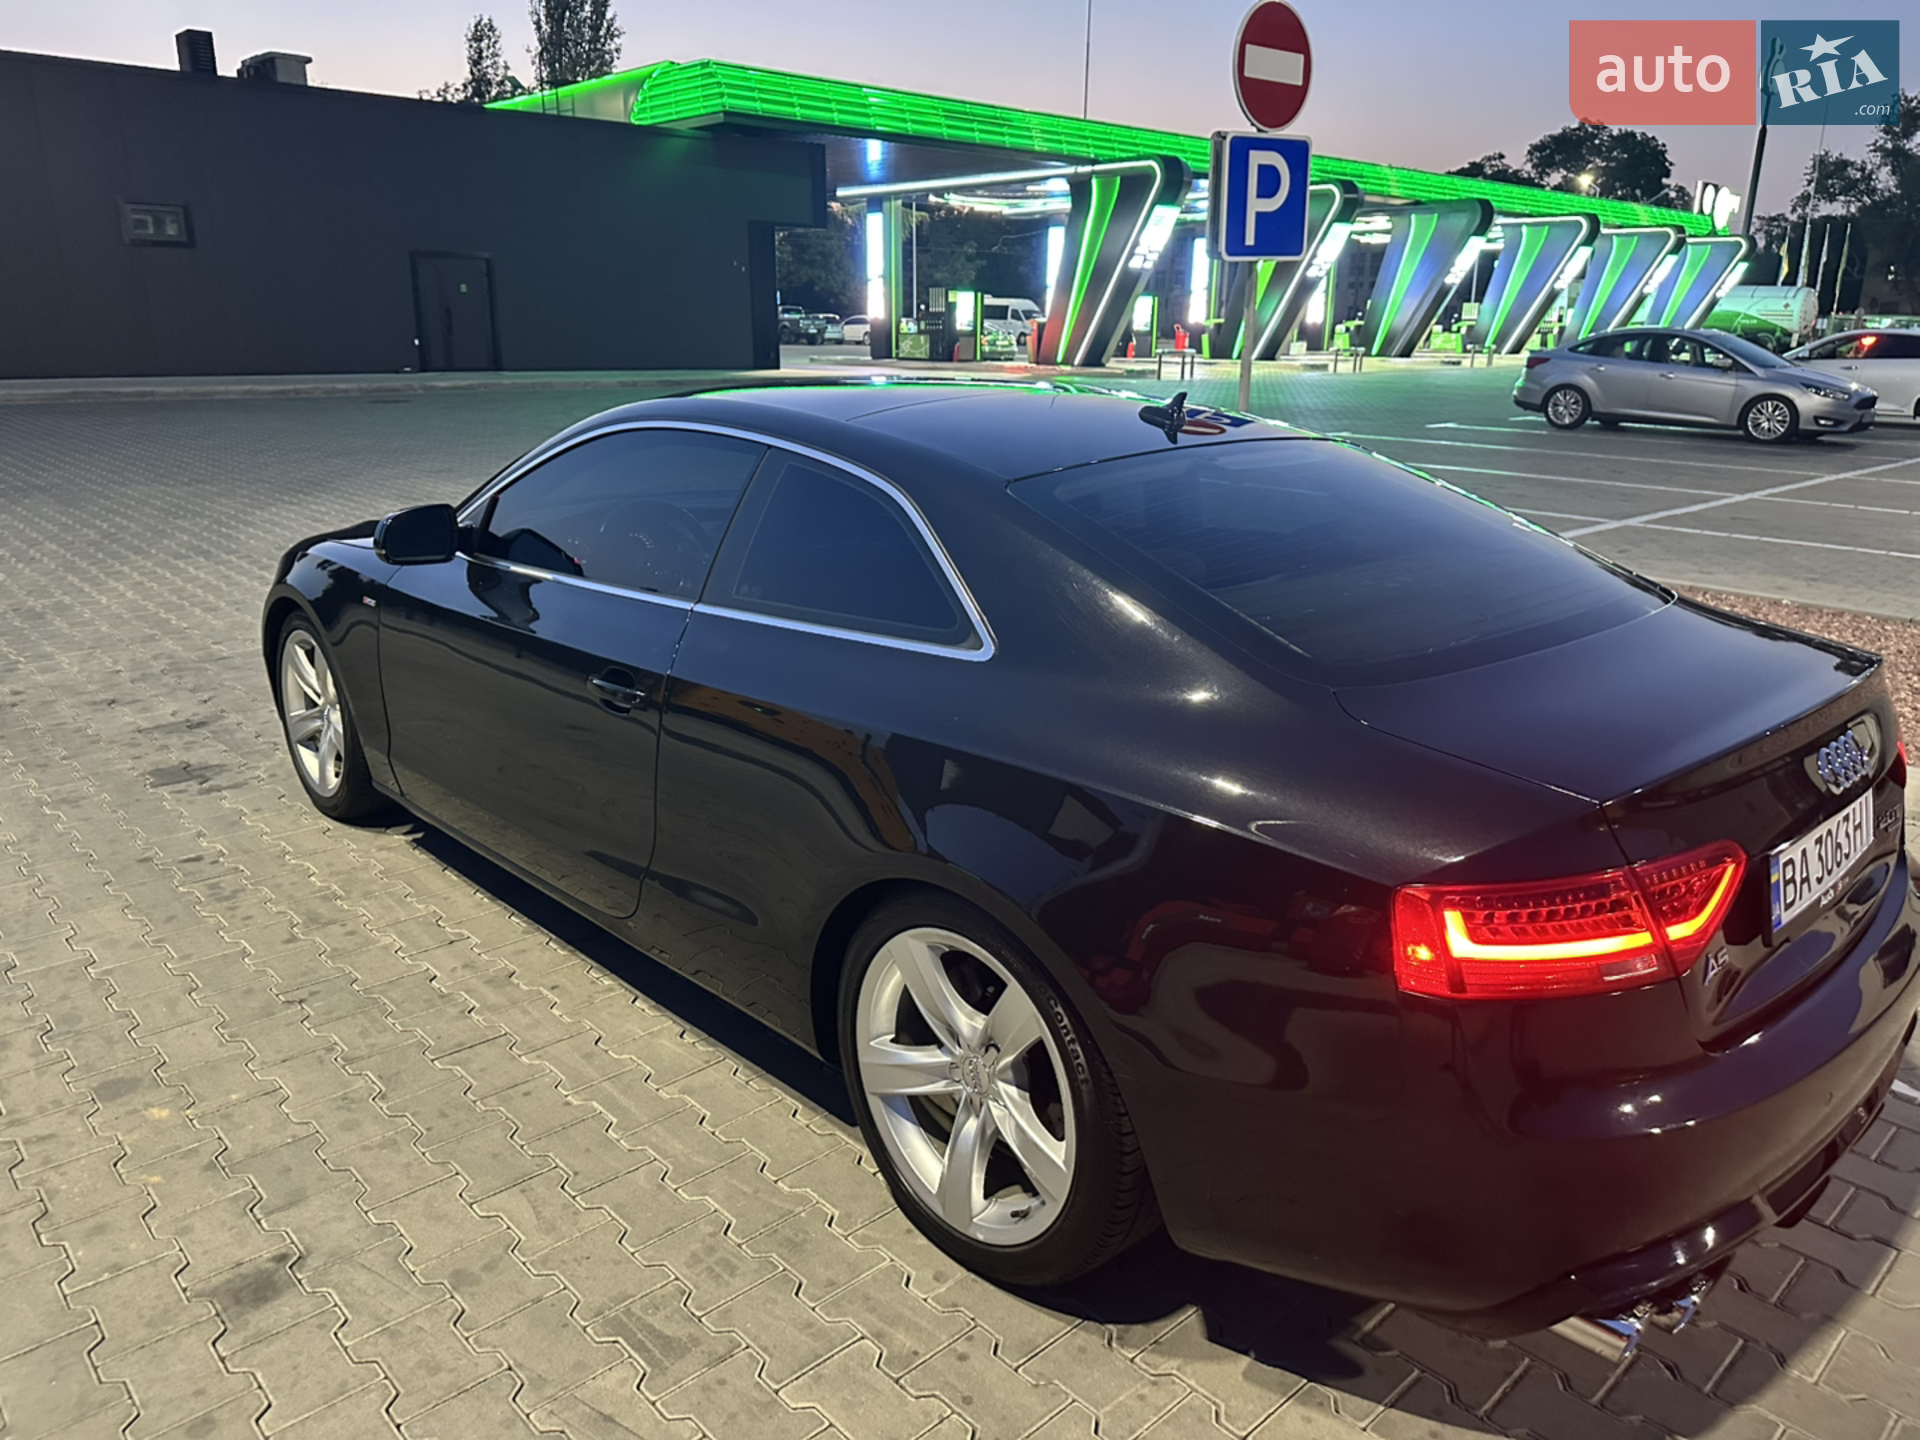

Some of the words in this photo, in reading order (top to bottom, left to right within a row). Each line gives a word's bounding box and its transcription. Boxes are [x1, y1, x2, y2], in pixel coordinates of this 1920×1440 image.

[1244, 149, 1291, 246] P
[1782, 847, 1812, 913] BA
[1814, 811, 1852, 885] 3063
